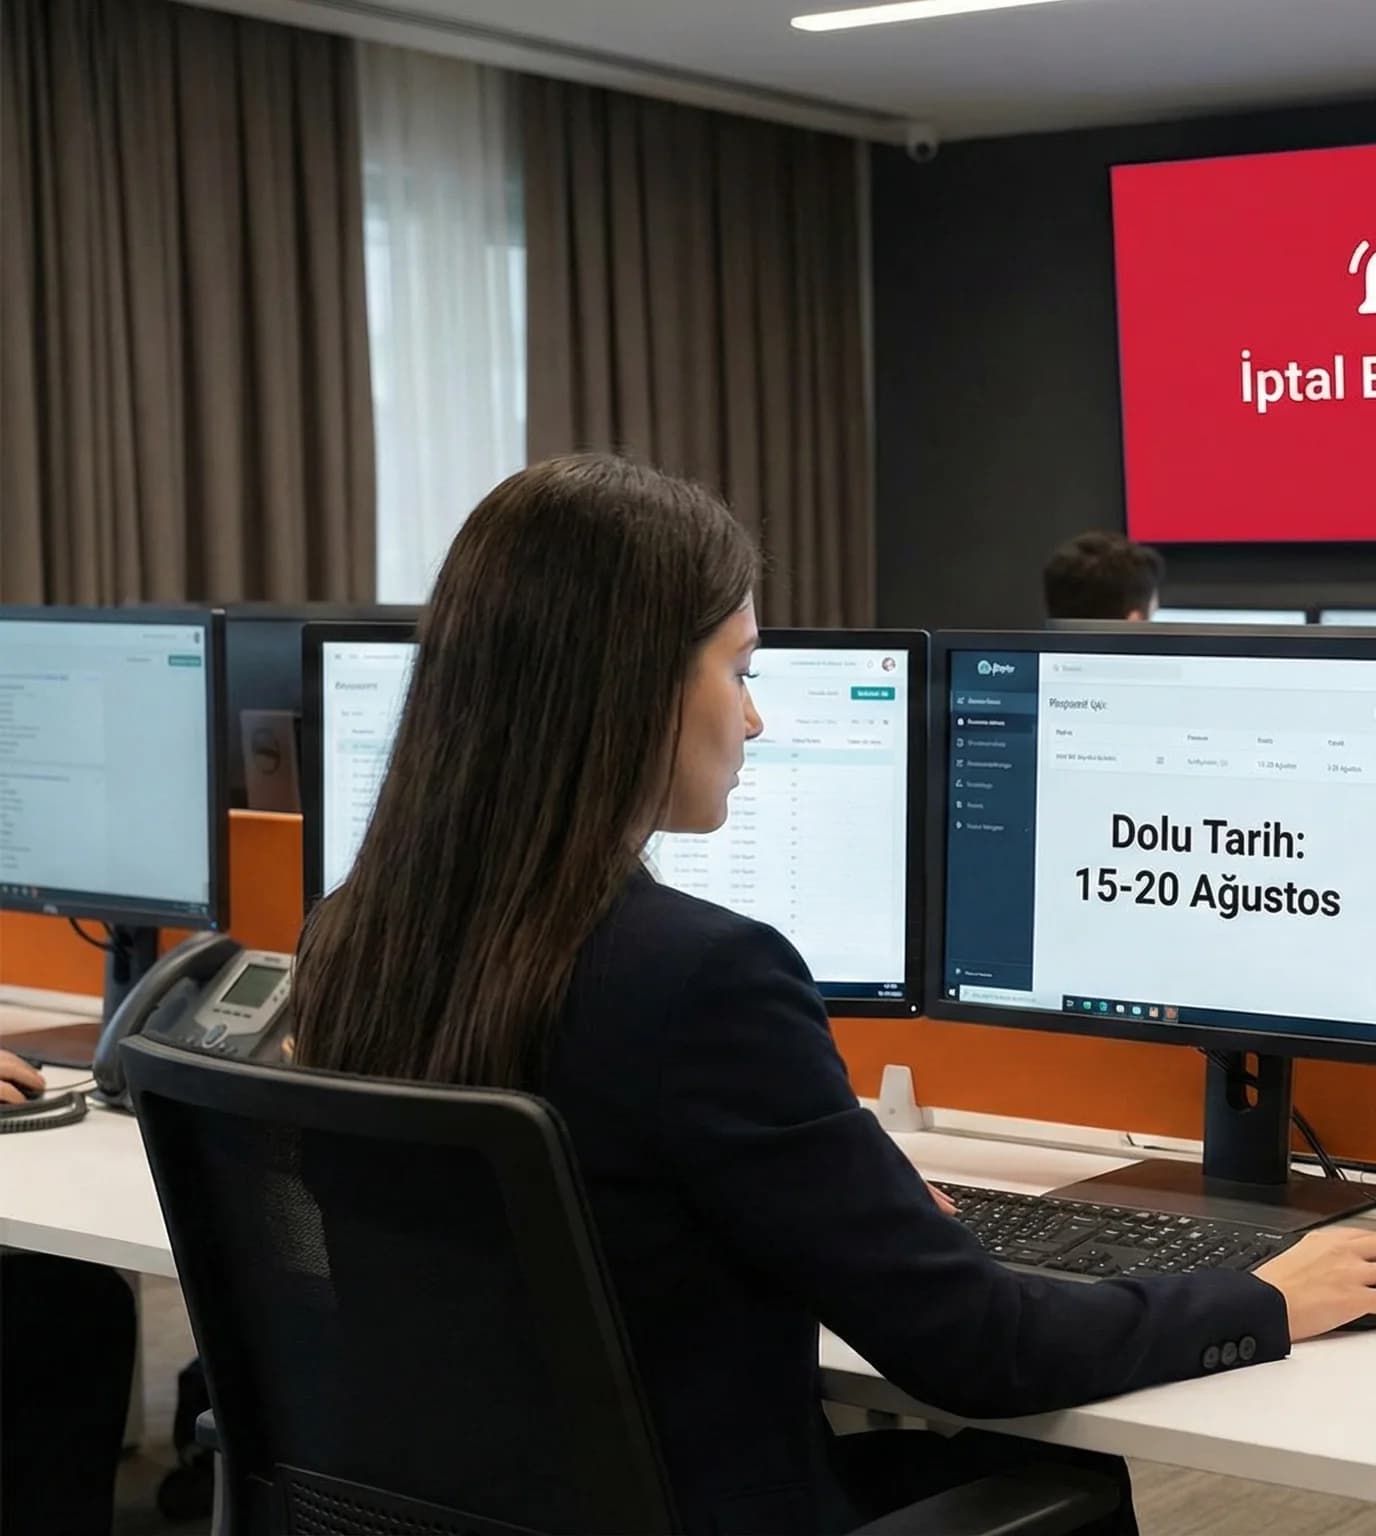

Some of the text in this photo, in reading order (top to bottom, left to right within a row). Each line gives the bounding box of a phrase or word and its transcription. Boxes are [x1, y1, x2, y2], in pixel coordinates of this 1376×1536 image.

[1241, 349, 1345, 414] İptal
[1112, 813, 1305, 860] Dolu Tarih:
[1075, 867, 1341, 920] 15-20 Ağustos
